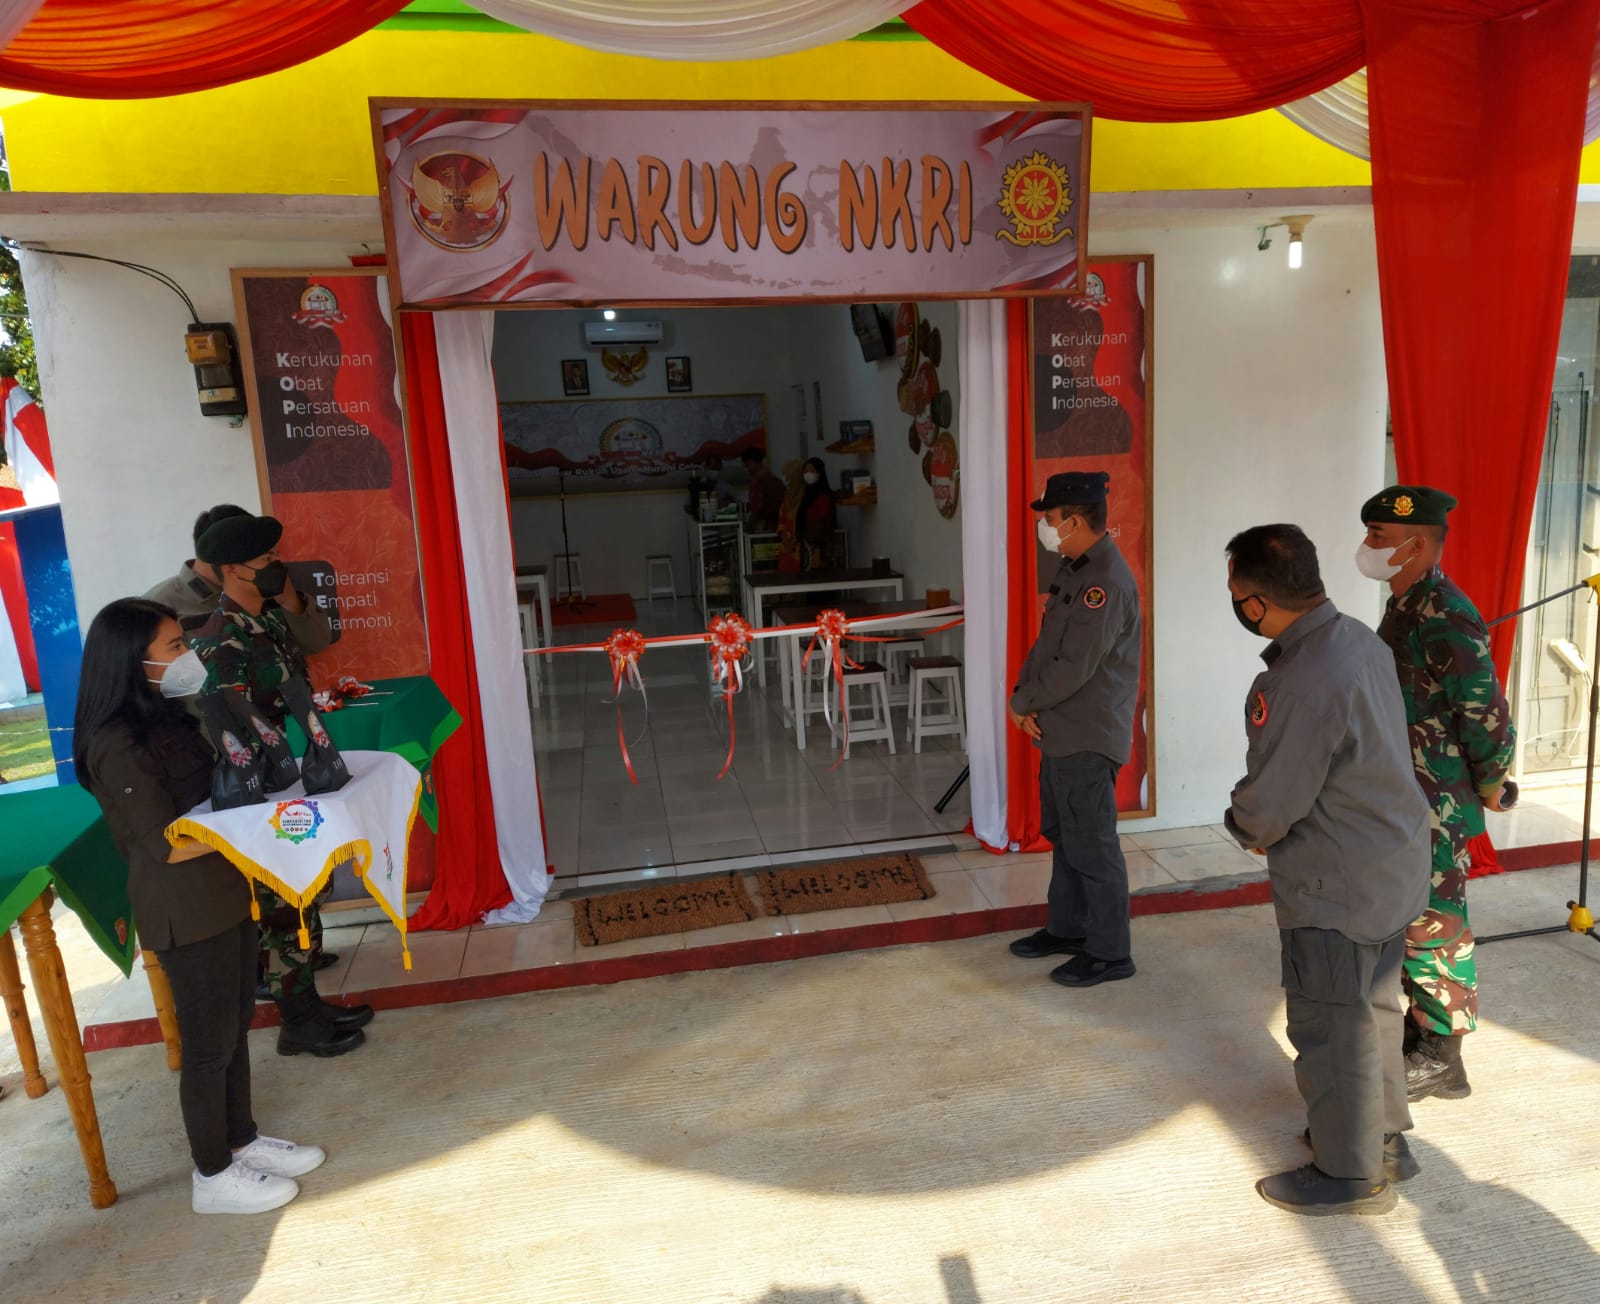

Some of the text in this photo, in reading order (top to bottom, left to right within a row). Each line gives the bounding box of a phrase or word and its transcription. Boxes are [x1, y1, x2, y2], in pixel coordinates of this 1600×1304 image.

[533, 150, 974, 254] WARUNG NKRI
[1051, 331, 1128, 348] Kerukunan
[275, 351, 373, 368] Kerukunan
[1051, 353, 1086, 368] Obat
[279, 375, 324, 391] Obat
[1052, 374, 1121, 389] Persatuan
[282, 400, 370, 415] Persatuan
[1052, 394, 1118, 410] Indonesia
[285, 421, 369, 438] Indonesia
[312, 567, 390, 587] Toleransi
[316, 590, 377, 611] Empati
